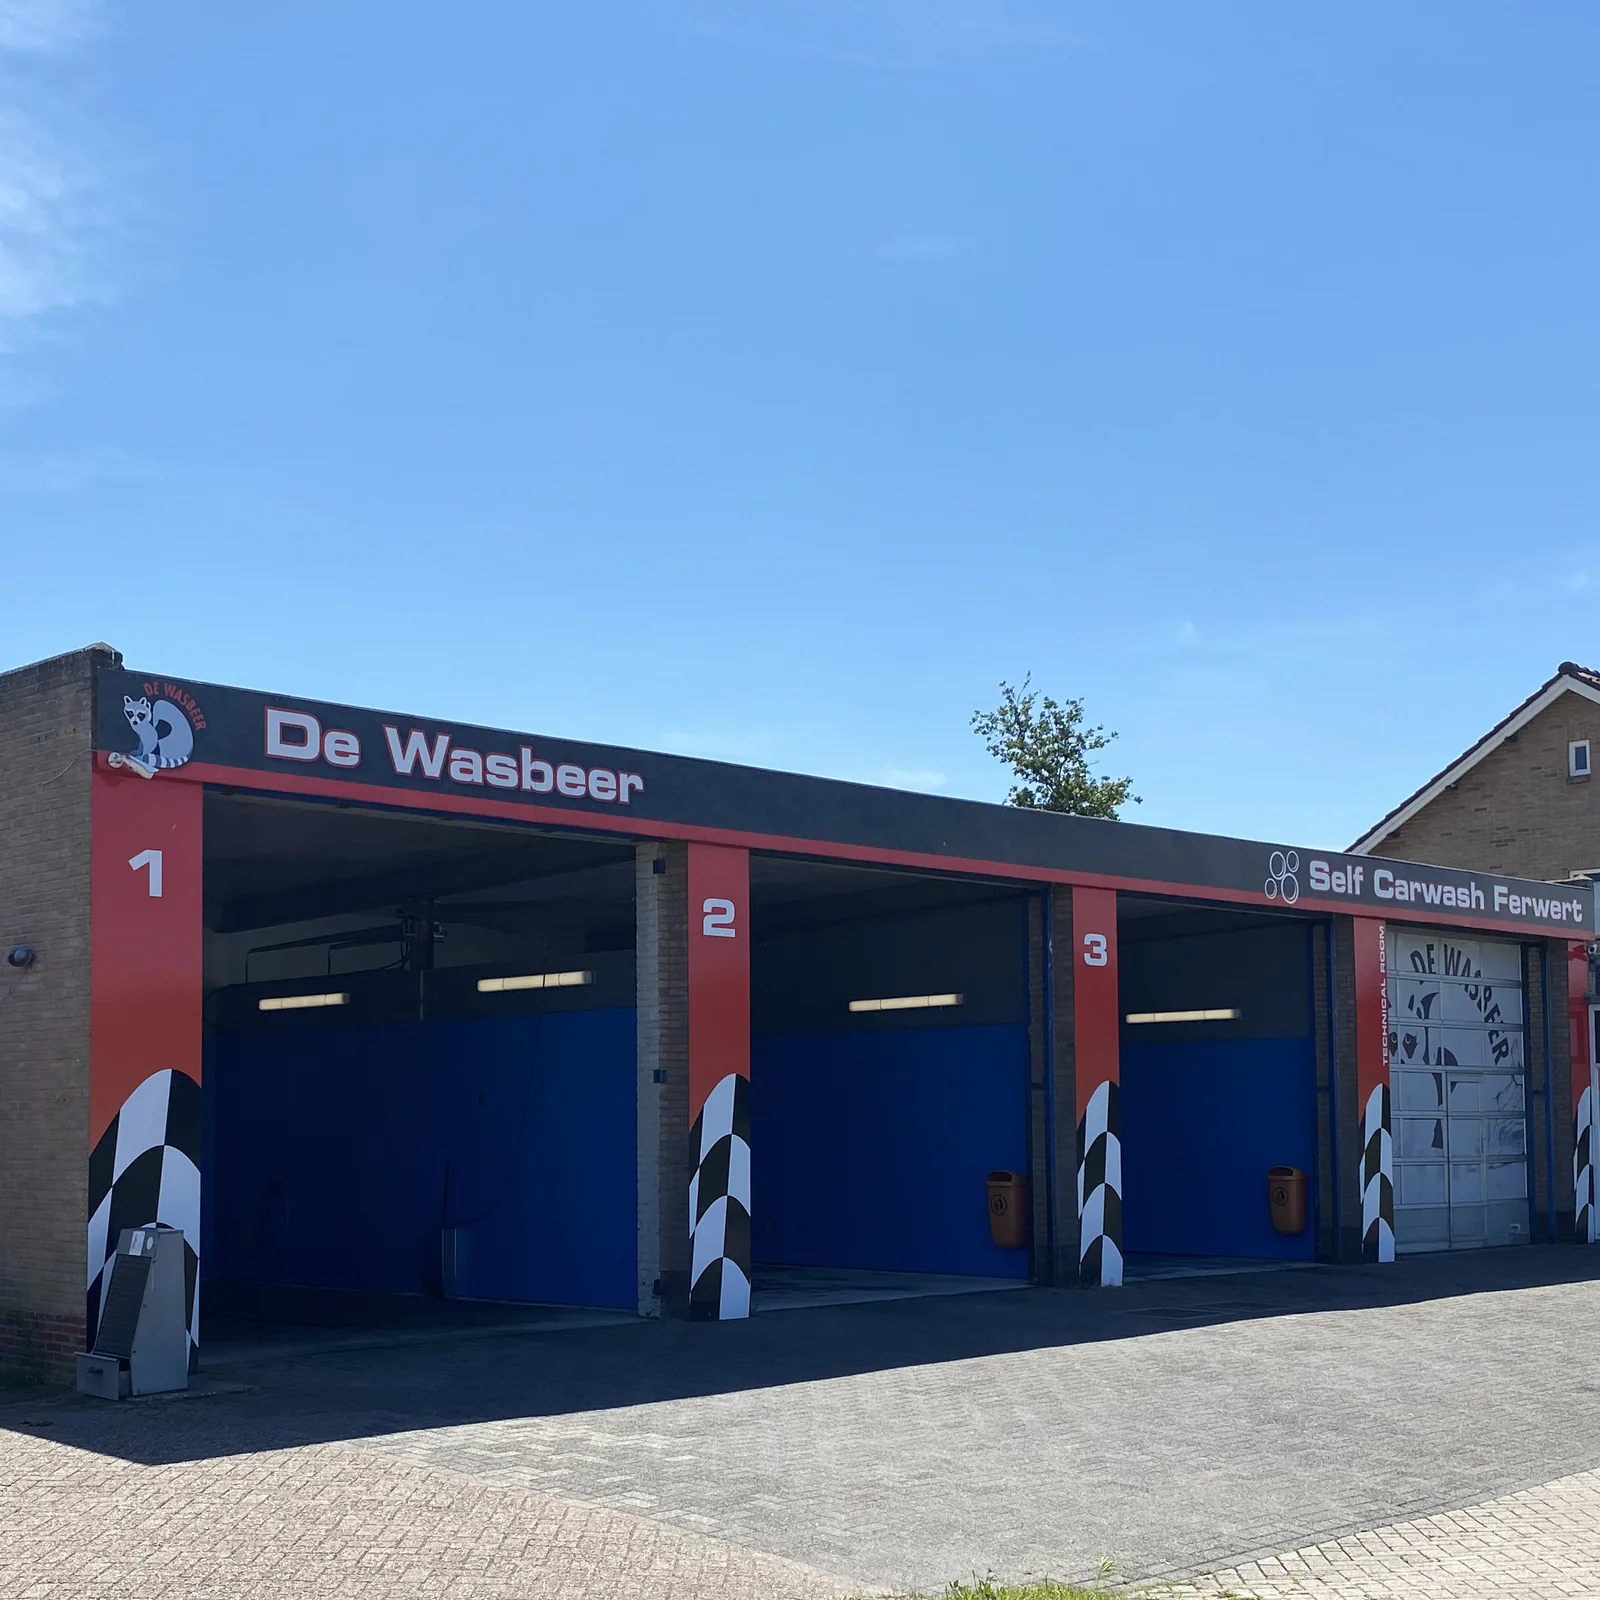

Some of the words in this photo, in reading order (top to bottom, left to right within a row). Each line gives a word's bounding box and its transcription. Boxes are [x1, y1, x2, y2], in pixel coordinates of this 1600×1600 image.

[143, 681, 161, 698] DE
[163, 682, 207, 731] WASBEER
[264, 706, 361, 768] De
[382, 724, 644, 804] Wasbeer
[128, 849, 163, 897] 1
[1308, 860, 1365, 895] Self
[1373, 869, 1485, 910] Carwash
[1493, 885, 1583, 923] Ferwert
[703, 898, 736, 938] 2
[1084, 933, 1108, 967] 3
[1381, 977, 1389, 1066] TECHNICAL
